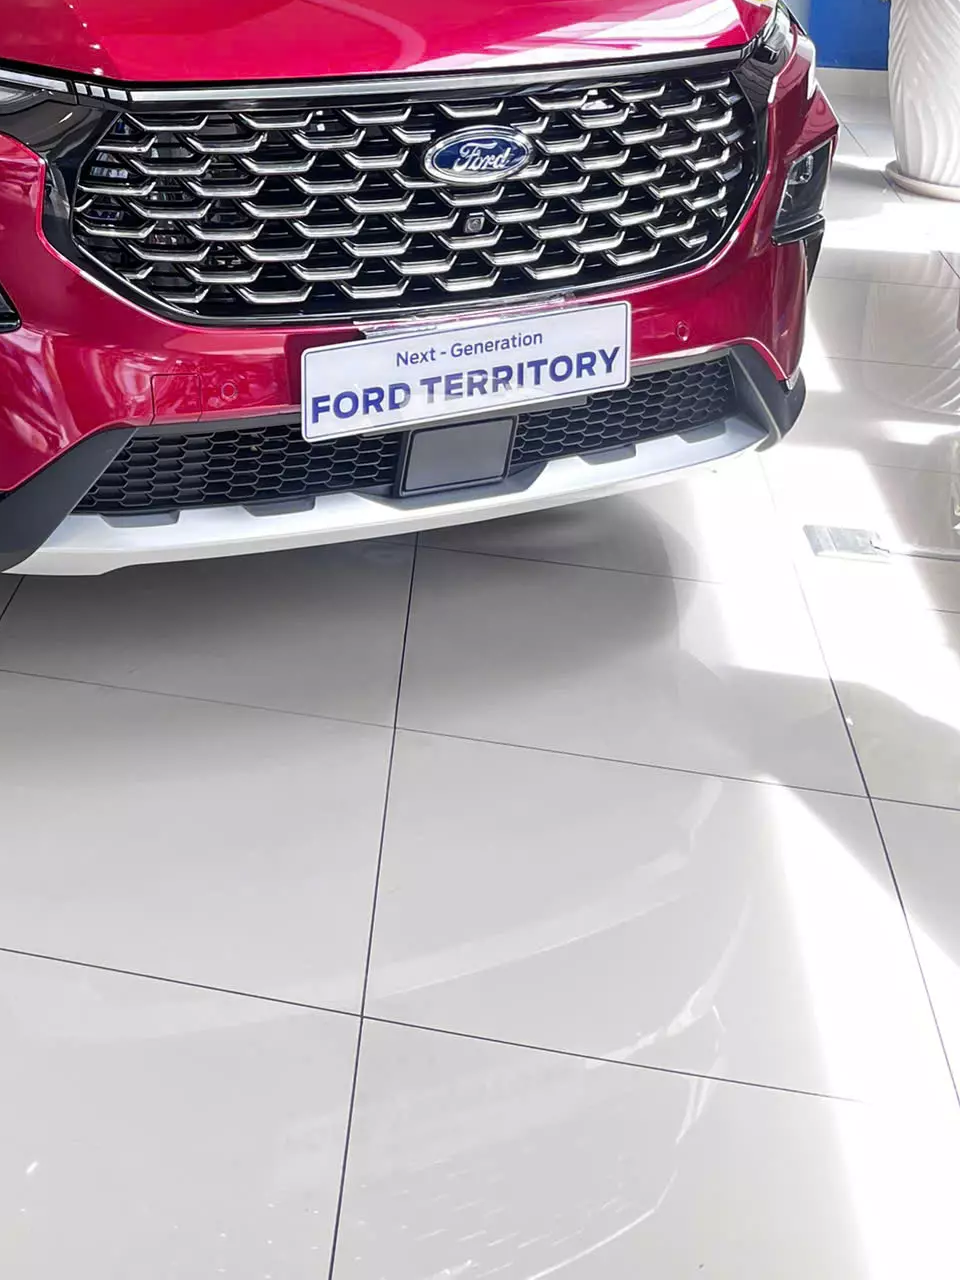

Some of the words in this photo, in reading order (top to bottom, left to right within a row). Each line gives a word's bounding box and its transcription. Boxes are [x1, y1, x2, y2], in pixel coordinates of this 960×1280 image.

[452, 141, 511, 172] Ford
[396, 347, 436, 367] Next
[450, 332, 543, 358] Generation
[311, 382, 411, 424] FORD
[420, 346, 620, 405] TERRITORY
